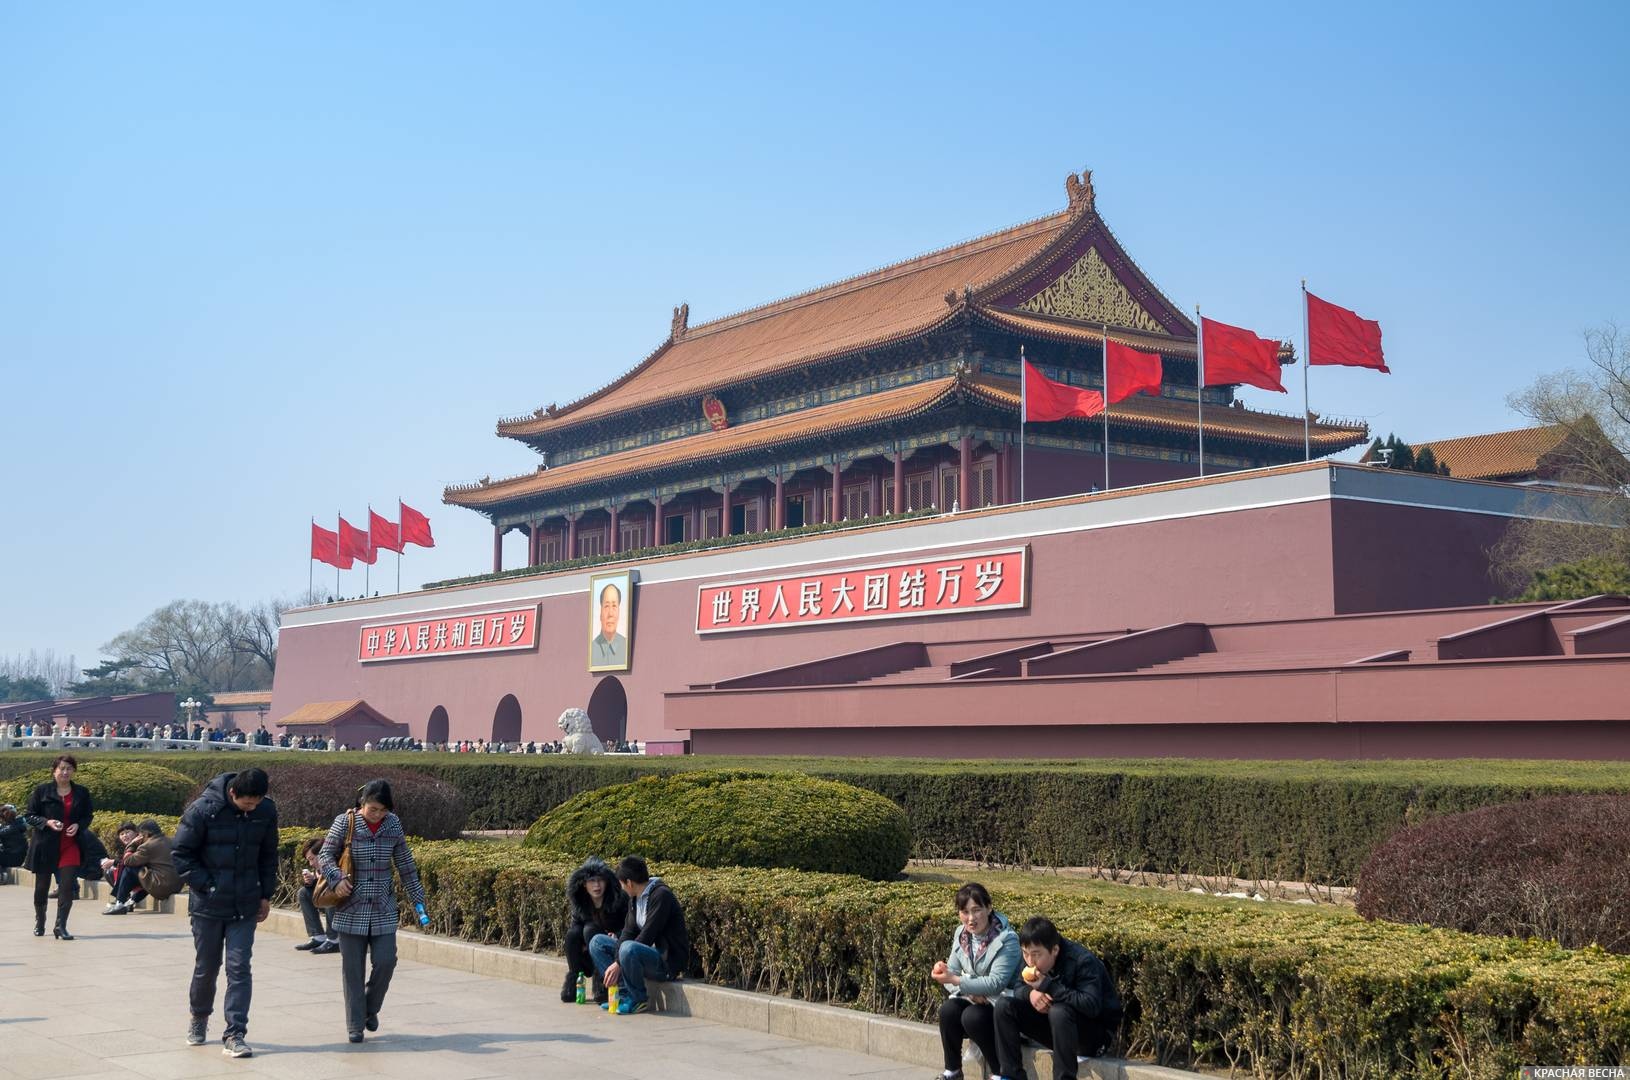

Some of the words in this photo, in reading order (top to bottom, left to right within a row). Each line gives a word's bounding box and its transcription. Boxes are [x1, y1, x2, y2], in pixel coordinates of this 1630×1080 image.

[711, 560, 1003, 625] 世界人民大团结万岁
[367, 614, 526, 656] 中华人民共和国万岁
